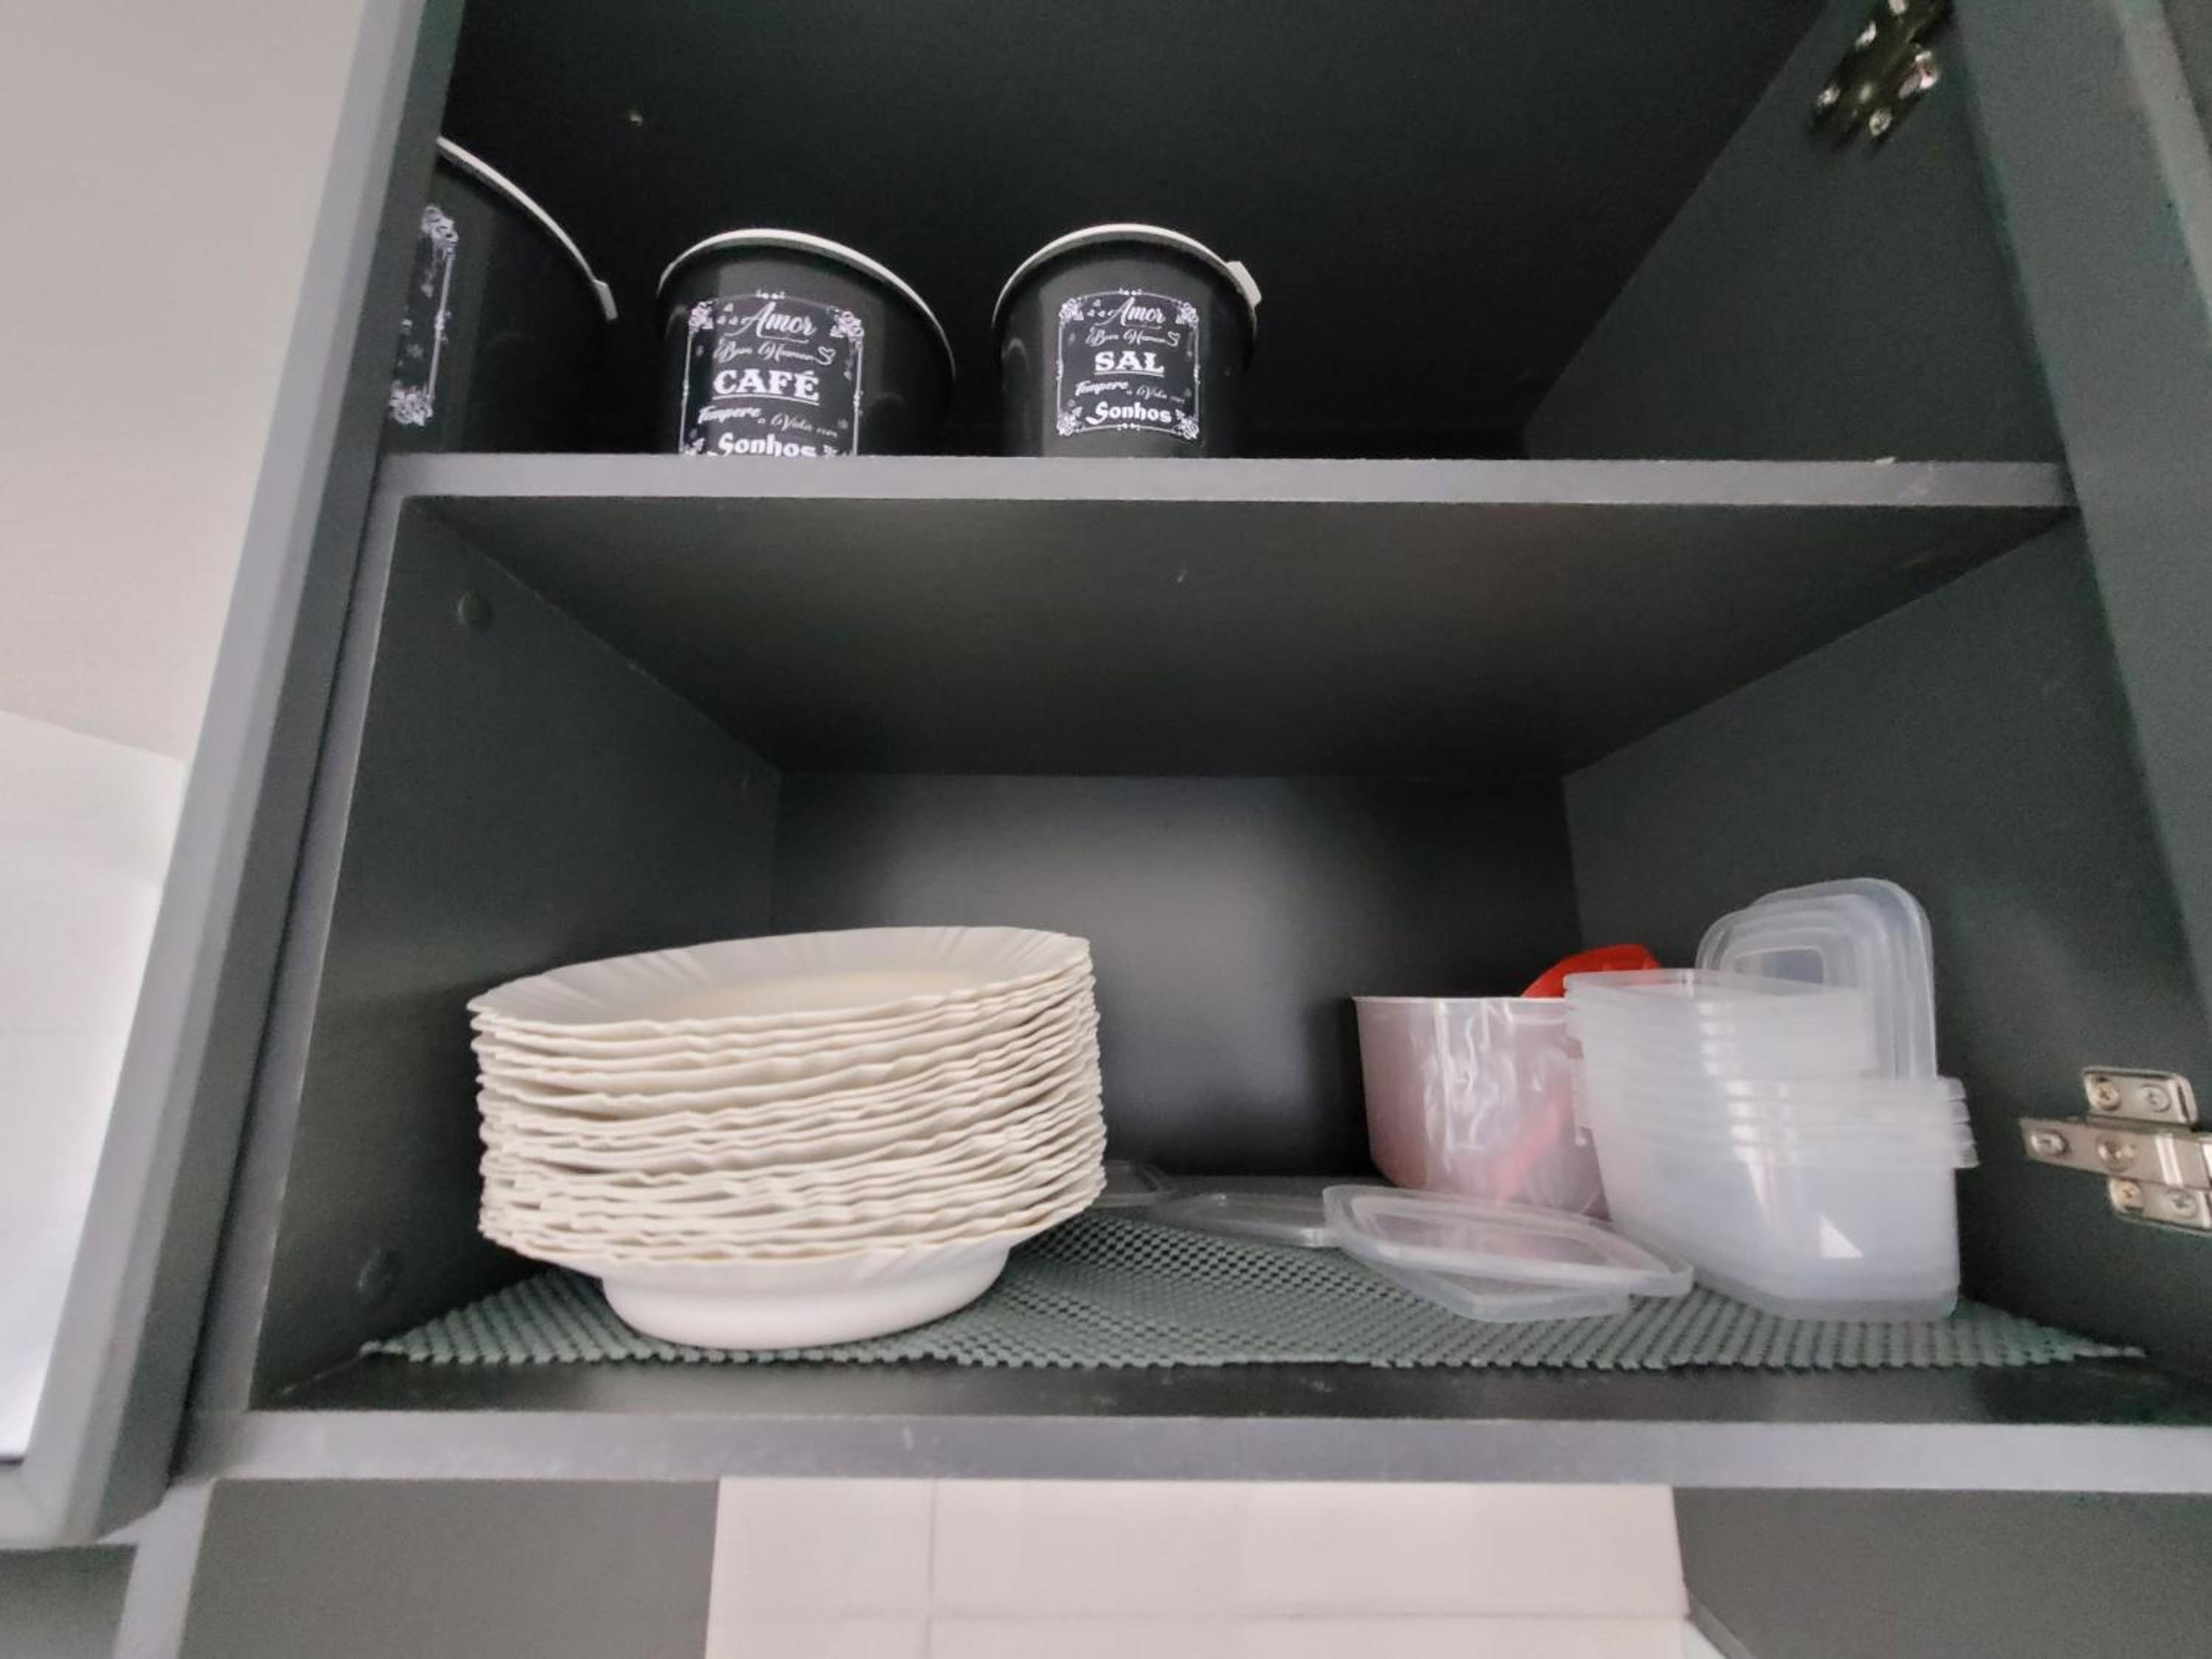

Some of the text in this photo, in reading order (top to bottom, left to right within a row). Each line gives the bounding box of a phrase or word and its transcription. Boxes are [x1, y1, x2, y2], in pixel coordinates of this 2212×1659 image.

[724, 302, 817, 342] Amor
[1093, 297, 1166, 329] Amor
[1094, 350, 1165, 373] SAL
[713, 369, 820, 401] CAFÉ
[1085, 401, 1172, 424] Sonhos
[718, 433, 817, 456] Sonhos
